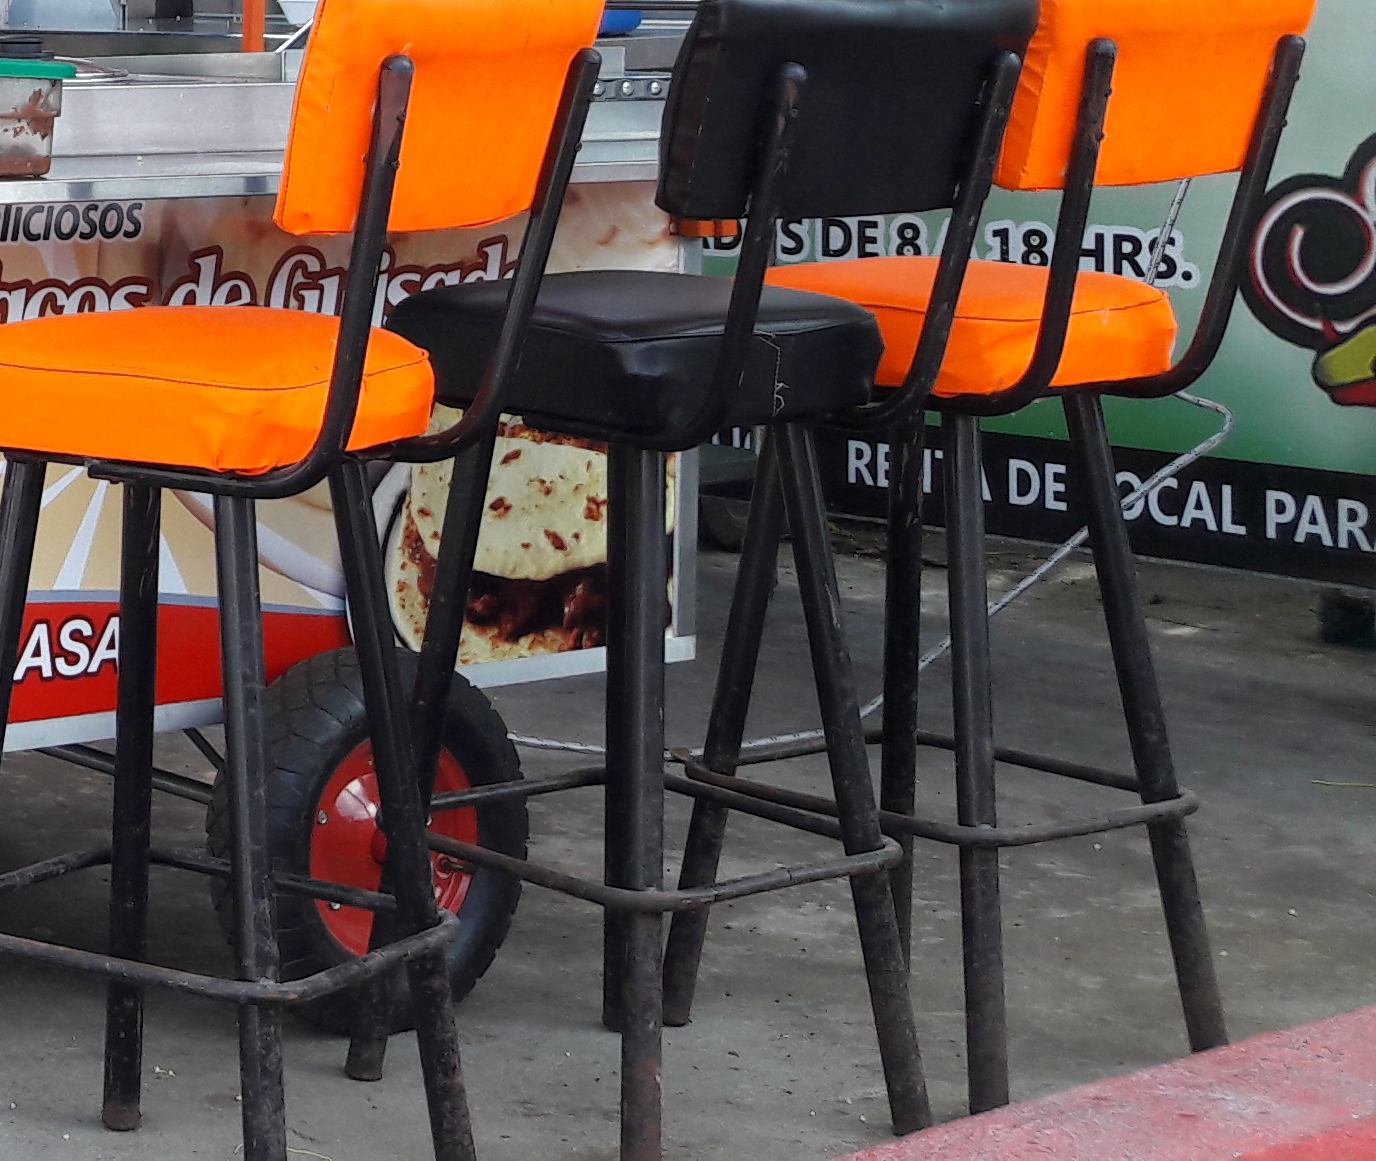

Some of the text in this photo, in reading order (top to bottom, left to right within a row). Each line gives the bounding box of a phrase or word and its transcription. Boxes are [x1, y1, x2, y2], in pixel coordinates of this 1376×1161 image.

[821, 219, 880, 258] DE
[896, 220, 922, 257] 8
[991, 228, 1048, 265] 18
[1077, 231, 1194, 282] HRS.
[1008, 458, 1069, 512] DE
[1114, 470, 1248, 537] OCAL
[1265, 488, 1376, 554] PAR
